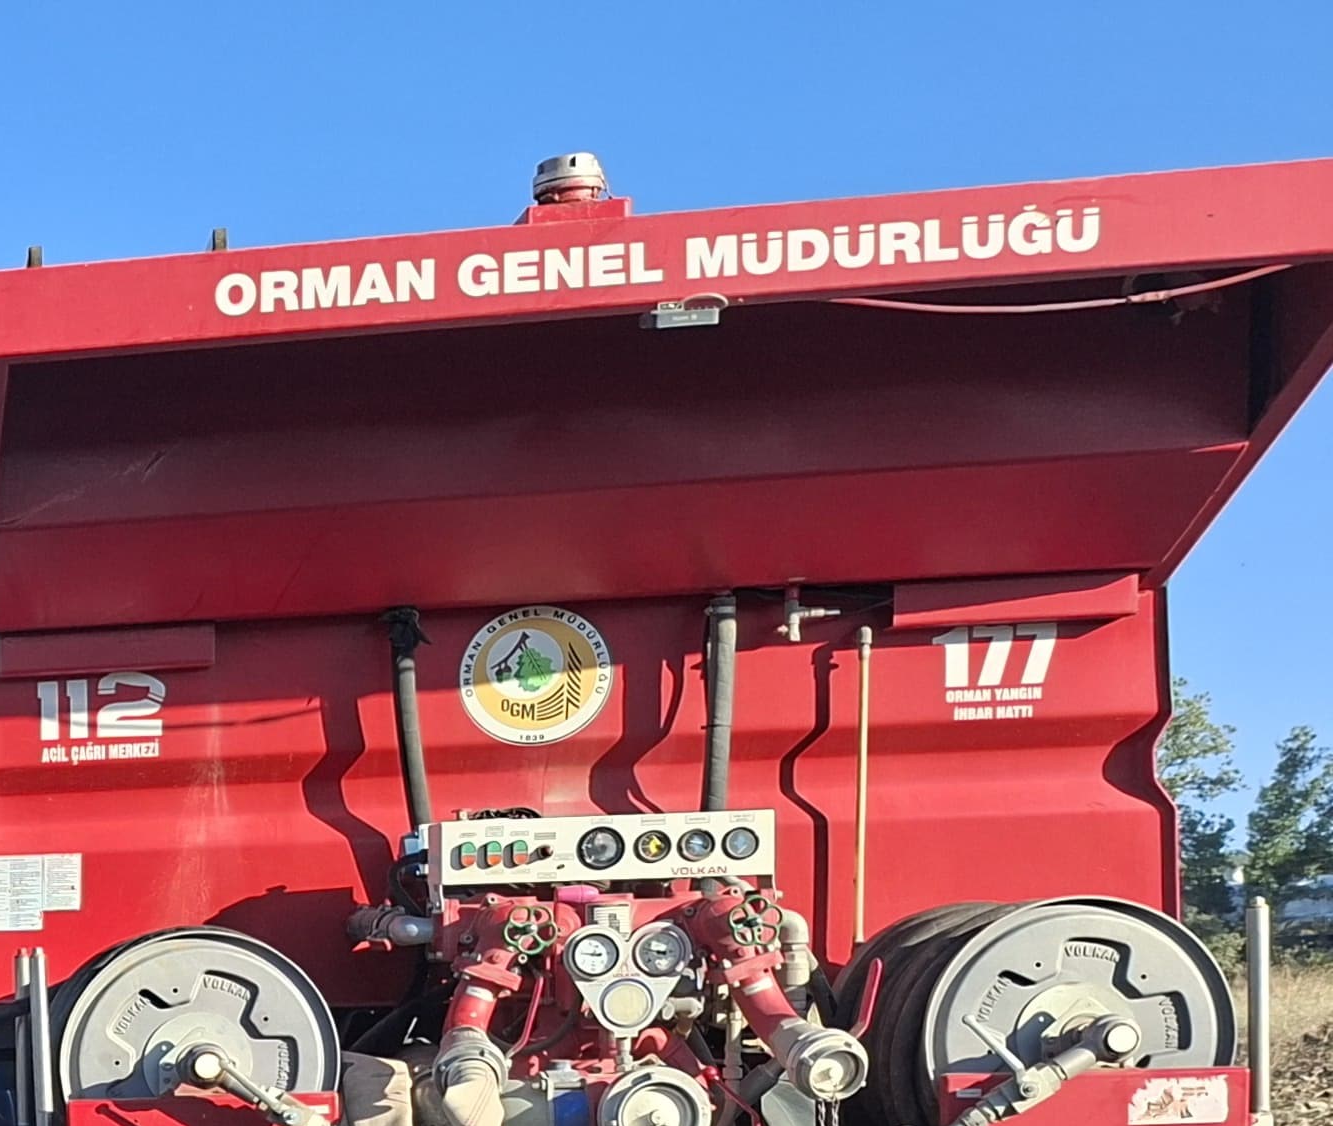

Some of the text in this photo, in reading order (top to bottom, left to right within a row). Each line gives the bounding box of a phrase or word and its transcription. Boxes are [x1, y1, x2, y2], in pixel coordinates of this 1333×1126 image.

[214, 204, 1100, 316] ORMAN GENEL MÜDÜRLÜĞÜ
[462, 641, 483, 697] ORMAN
[486, 608, 541, 635] GENEL
[932, 622, 1057, 688] 177
[37, 671, 166, 741] 112
[945, 686, 1042, 703] ORMAN YANGIN
[501, 698, 536, 721] OGM
[953, 704, 1033, 721] İHBAR HATTI
[41, 739, 160, 766] ACİL ÇAĞRI MERKEZİ
[671, 865, 728, 875] VOLKAN
[1064, 944, 1121, 964] VOLKAN
[202, 976, 251, 1001] VOLKAN
